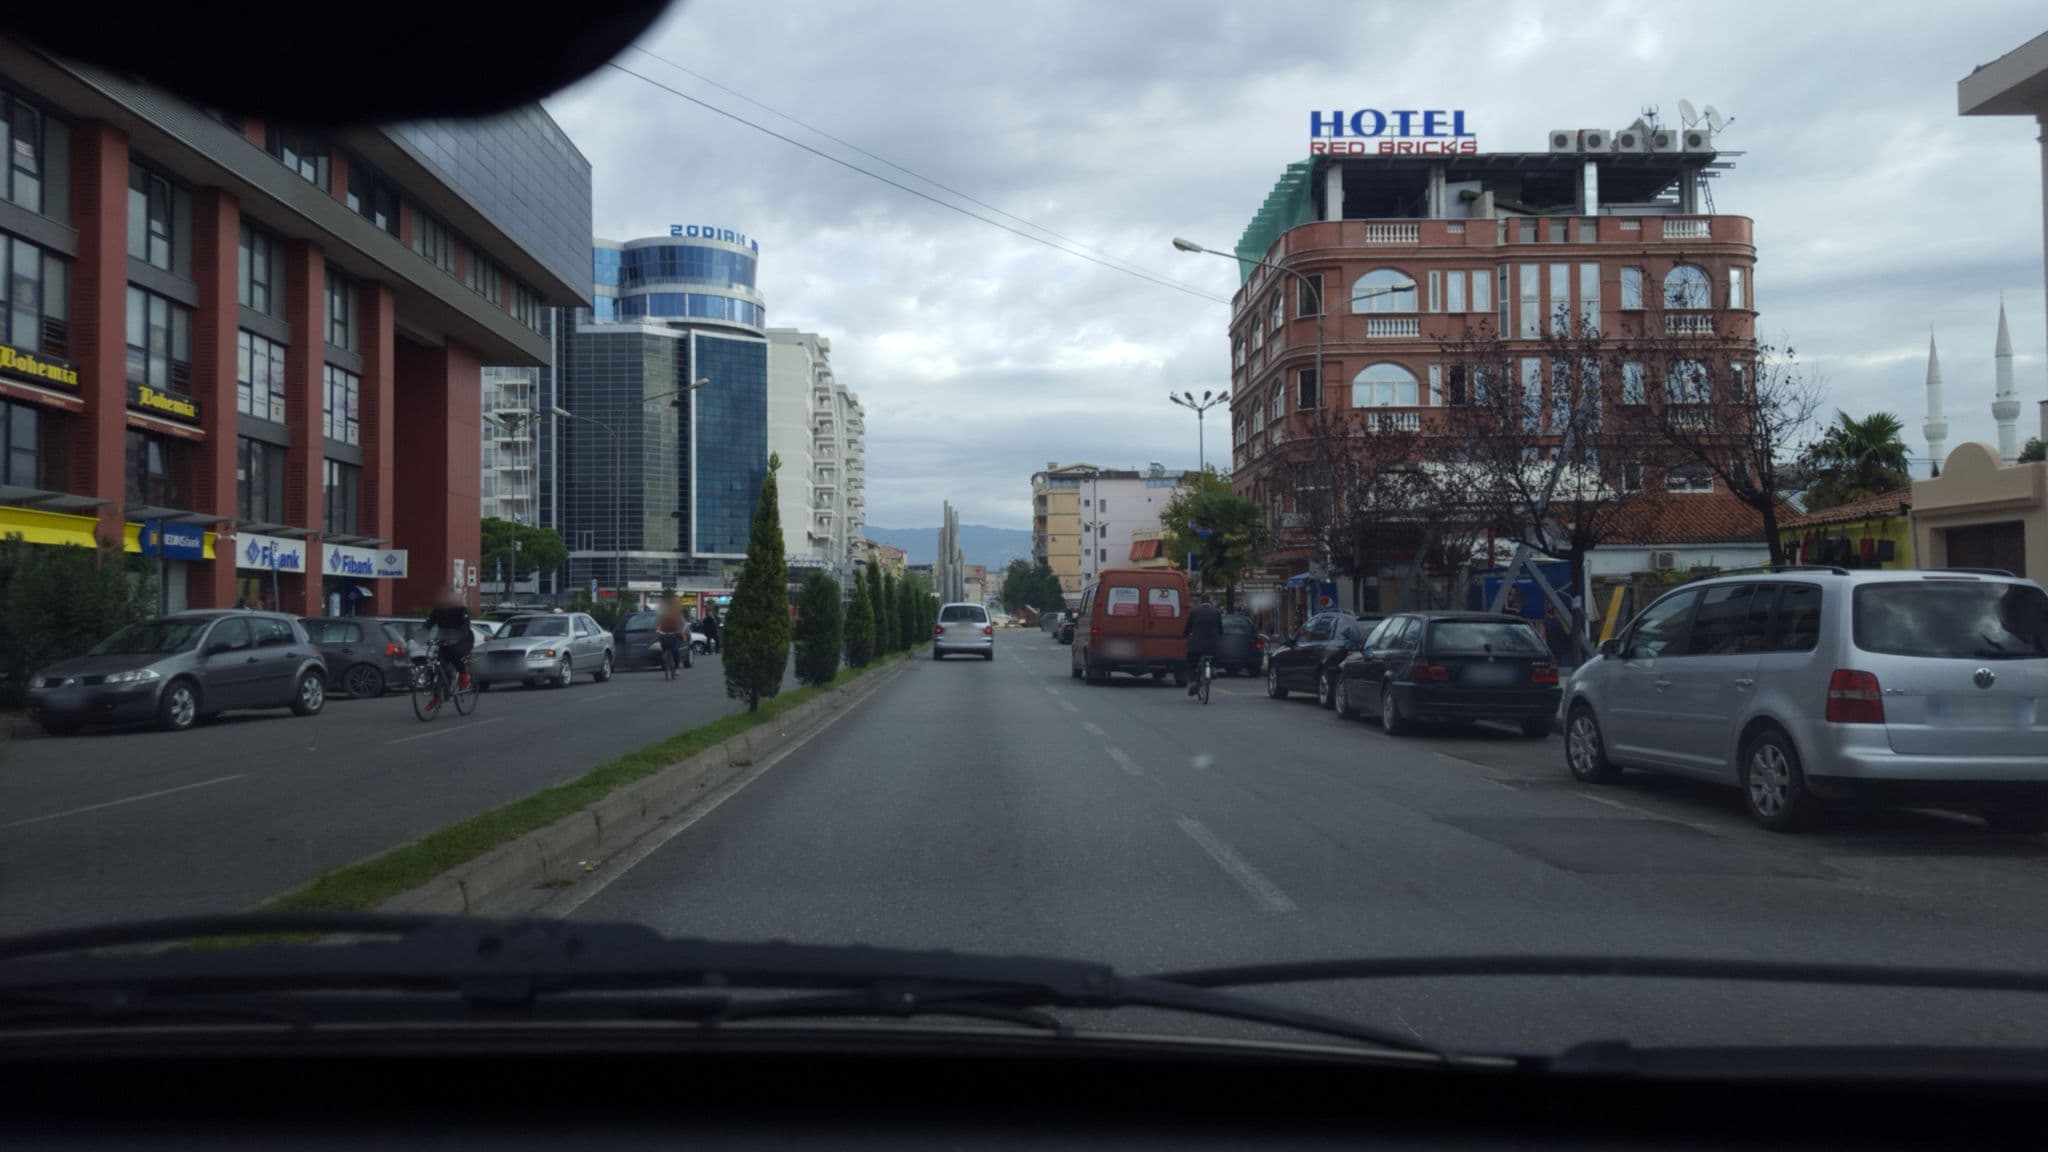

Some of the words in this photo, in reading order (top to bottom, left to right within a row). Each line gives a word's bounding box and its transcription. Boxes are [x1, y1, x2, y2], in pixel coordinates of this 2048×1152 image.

[1311, 109, 1476, 137] HOTEL
[1310, 141, 1365, 155] RED
[1378, 141, 1478, 155] BRICKS
[0, 345, 78, 385] Bohemia
[138, 384, 196, 417] Bohemia
[262, 545, 300, 569] Fiank
[342, 555, 373, 575] Fibank
